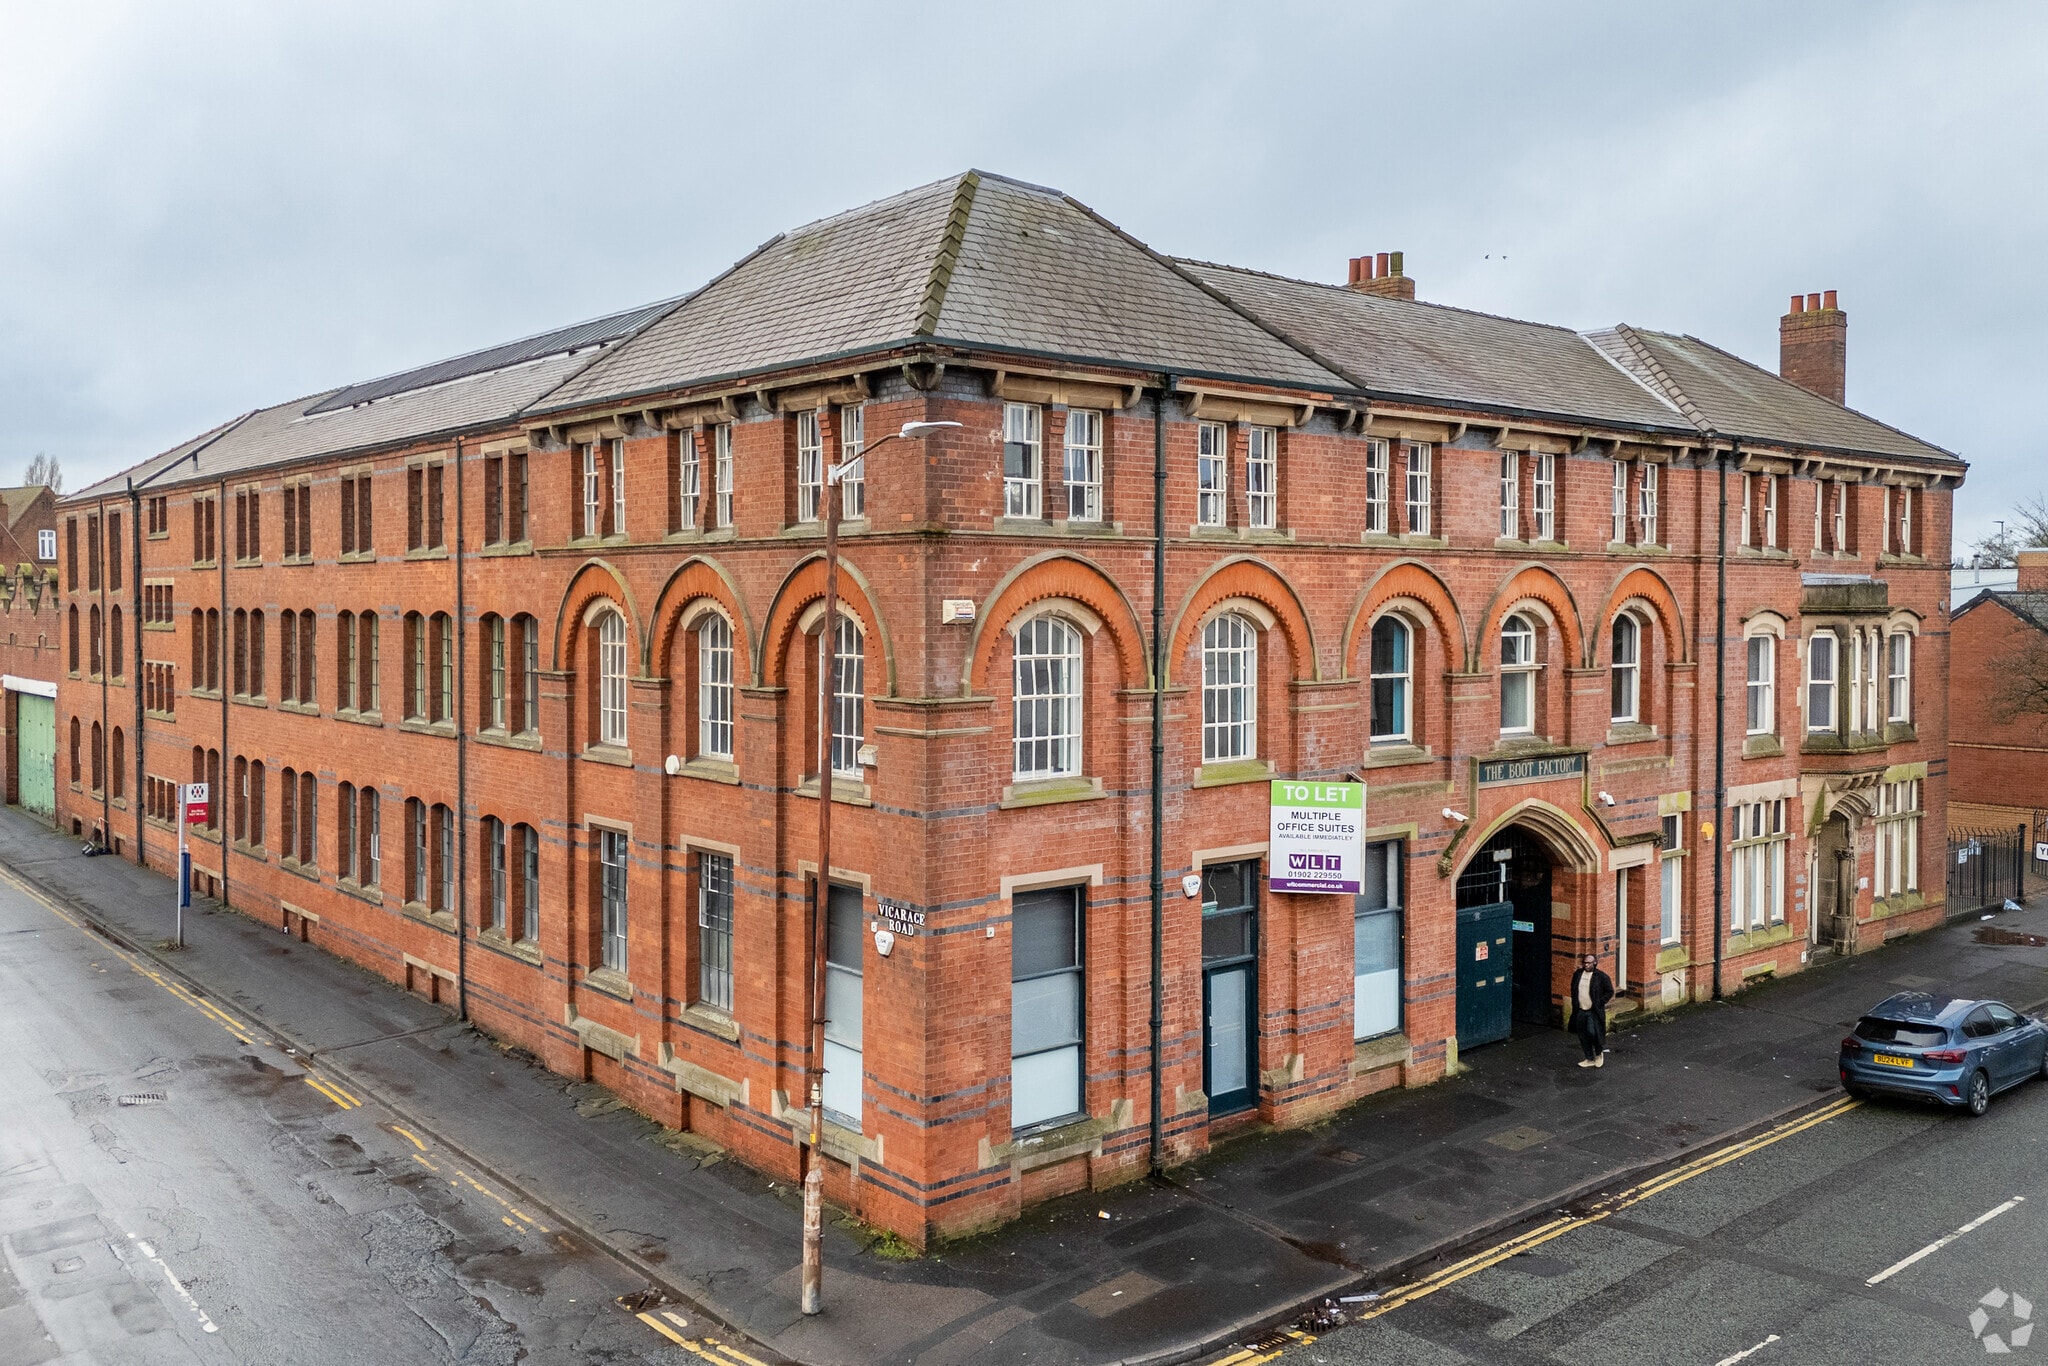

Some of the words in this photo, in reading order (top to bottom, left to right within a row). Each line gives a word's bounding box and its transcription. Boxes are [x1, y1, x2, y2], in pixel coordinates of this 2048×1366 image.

[1484, 764, 1504, 780] THE
[1509, 761, 1534, 779] BOOT
[1538, 757, 1576, 775] FACTORY
[1283, 785, 1309, 801] TO
[1314, 786, 1350, 802] LET
[1290, 811, 1341, 821] MULTIPLE
[1277, 822, 1314, 832] OFFICE
[1317, 824, 1355, 833] SUITES
[1289, 854, 1340, 870] WLT
[1313, 871, 1342, 879] 229550
[878, 903, 925, 926] VICARAGE
[889, 919, 914, 936] ROAD
